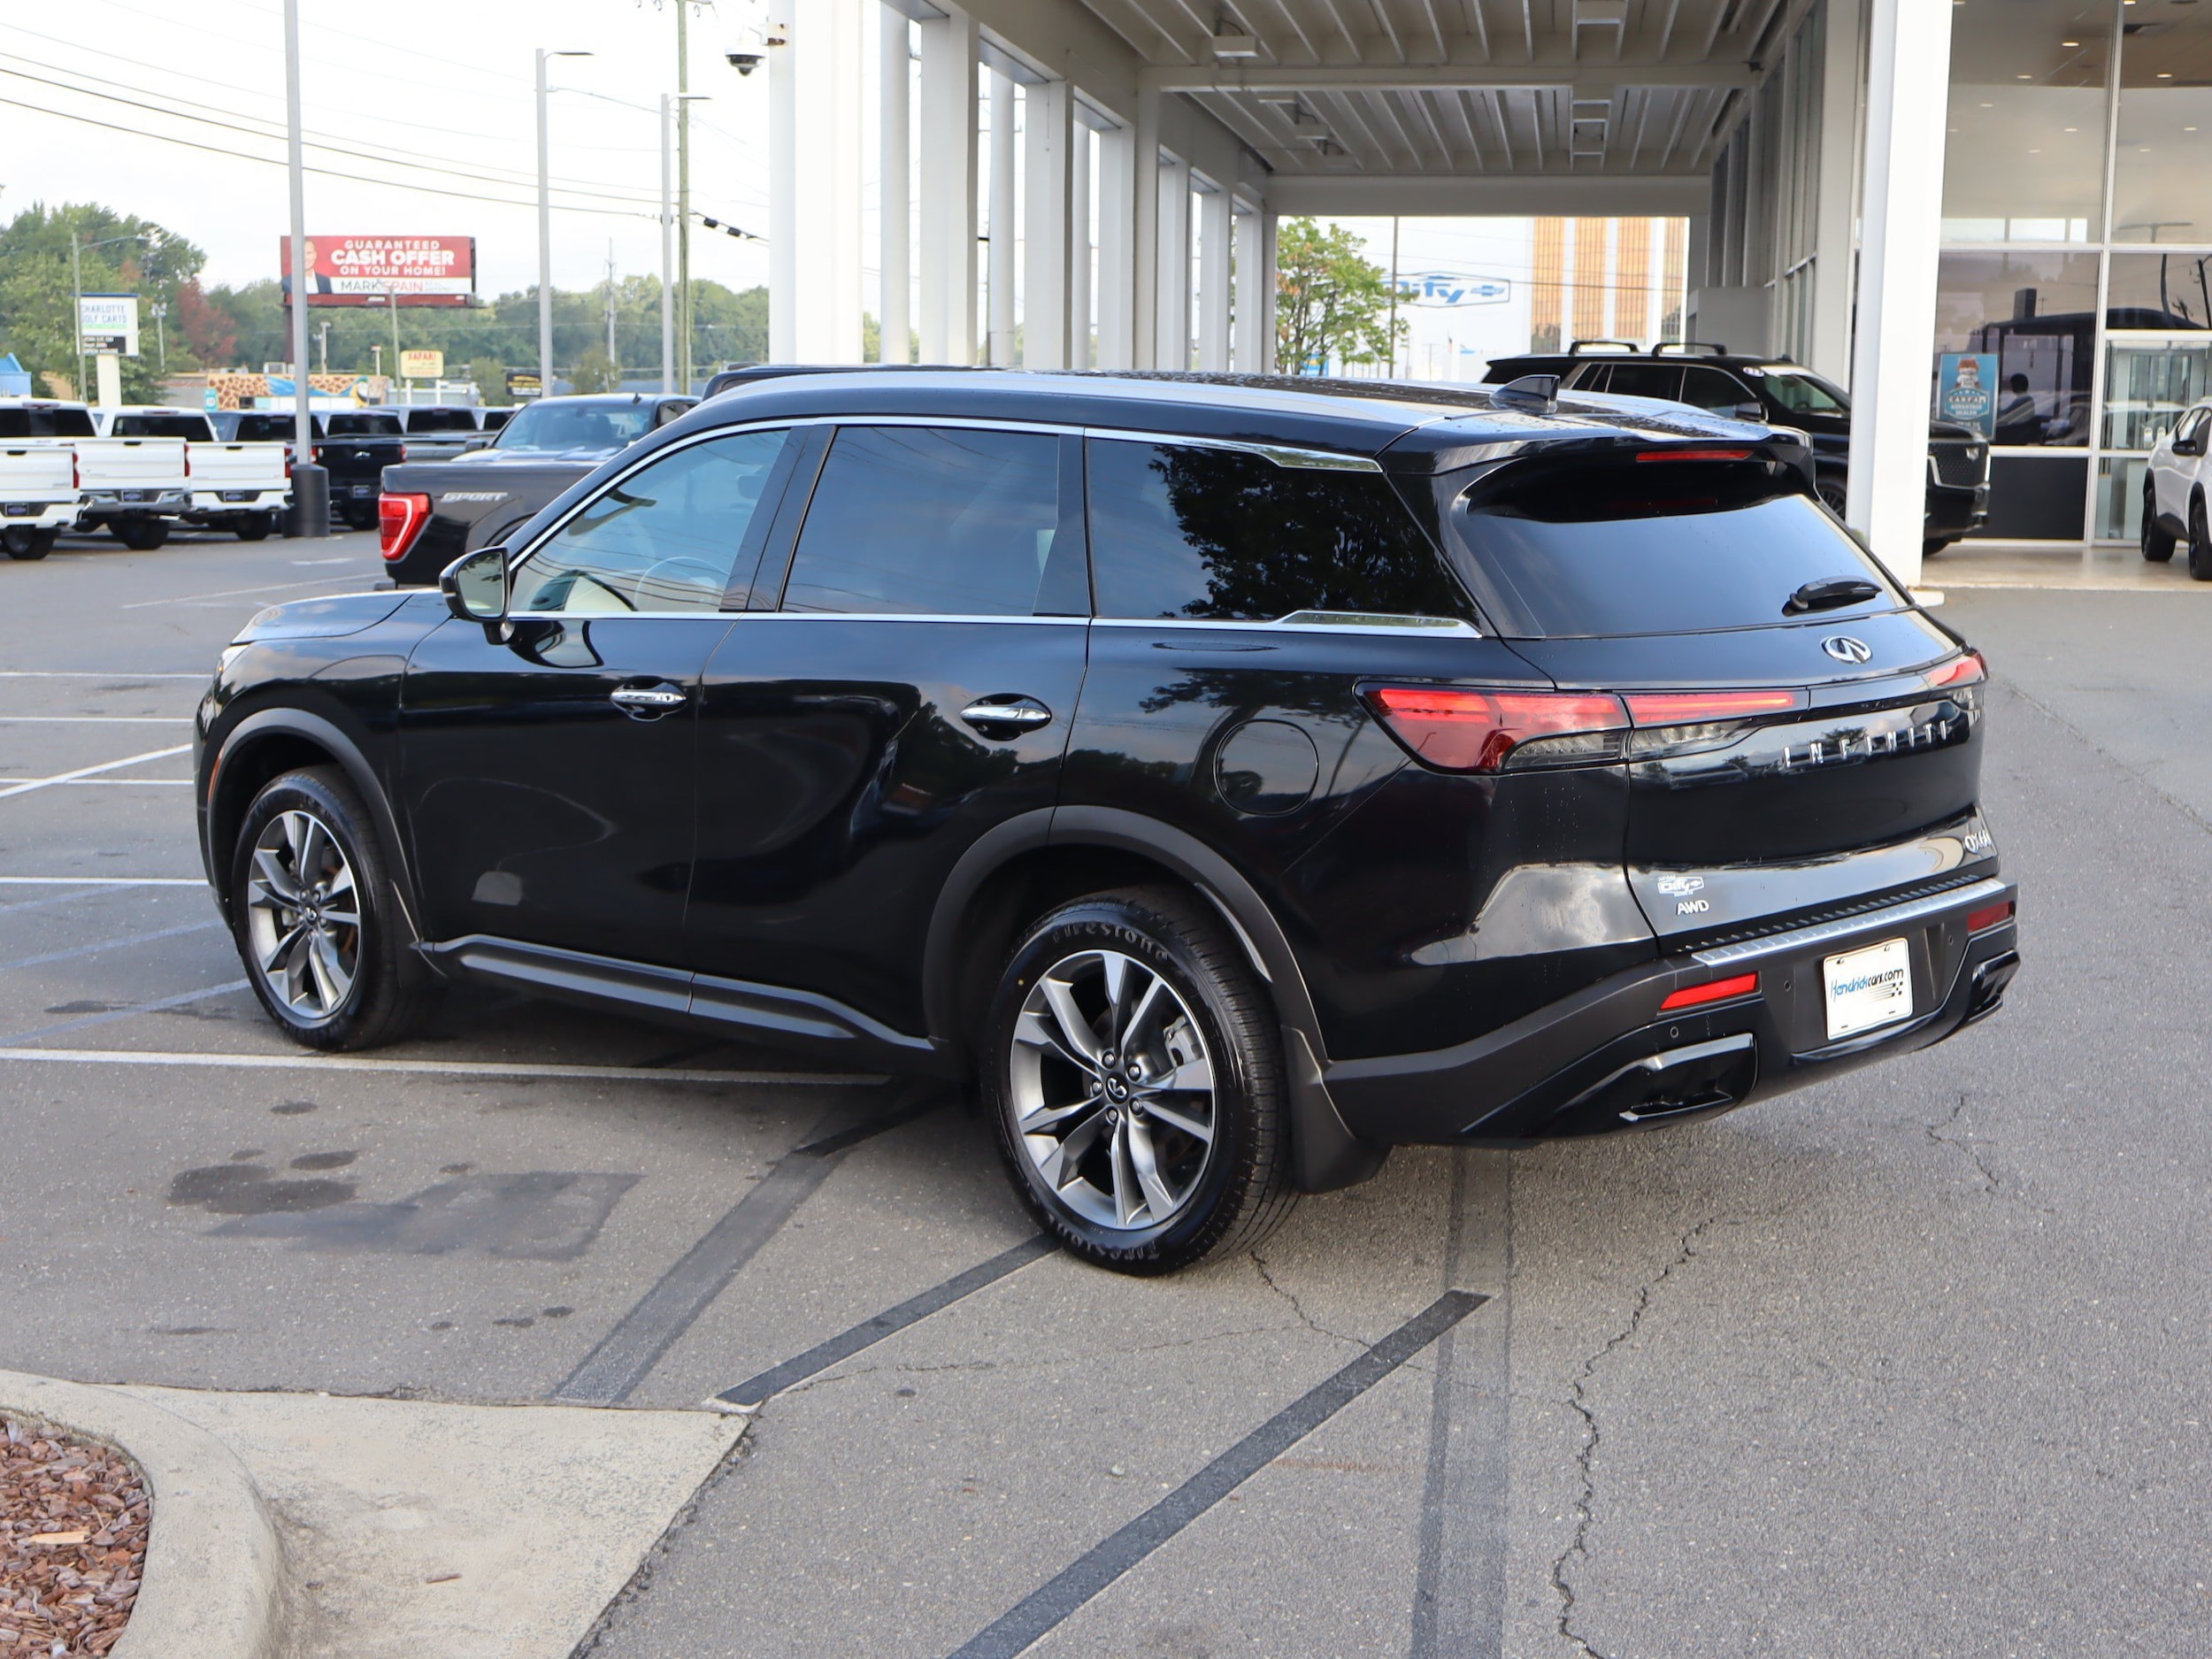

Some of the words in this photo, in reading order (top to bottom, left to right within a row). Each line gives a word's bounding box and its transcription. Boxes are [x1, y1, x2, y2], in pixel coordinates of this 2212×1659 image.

[344, 241, 441, 250] GUARANTEED
[331, 250, 386, 265] CASH
[390, 250, 455, 265] OFFER
[340, 265, 359, 275] ON
[364, 265, 399, 275] YOUR
[403, 266, 446, 276] HOME!
[102, 314, 127, 323] CARTS
[408, 351, 436, 361] SAFARI
[440, 491, 510, 503] SPORT
[1783, 719, 1947, 768] INFINITI
[1677, 899, 1710, 916] AWD
[1830, 967, 1904, 1003] Hendrickcars.com
